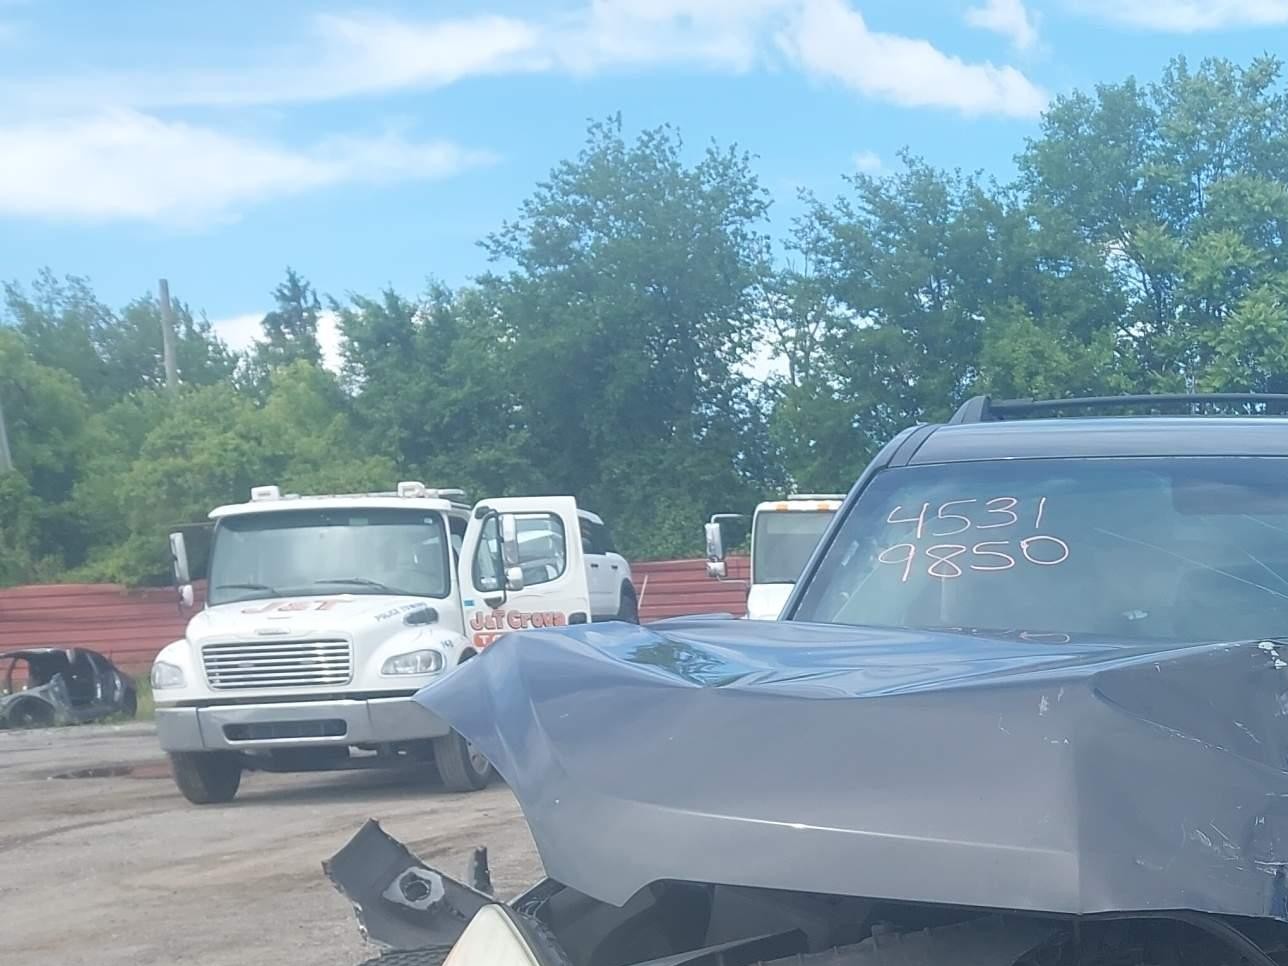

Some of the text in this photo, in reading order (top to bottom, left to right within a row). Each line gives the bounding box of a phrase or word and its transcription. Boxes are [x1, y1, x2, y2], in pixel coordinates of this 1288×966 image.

[887, 496, 1047, 539] 4531
[878, 535, 1069, 582] 9850
[470, 610, 505, 631] J&T
